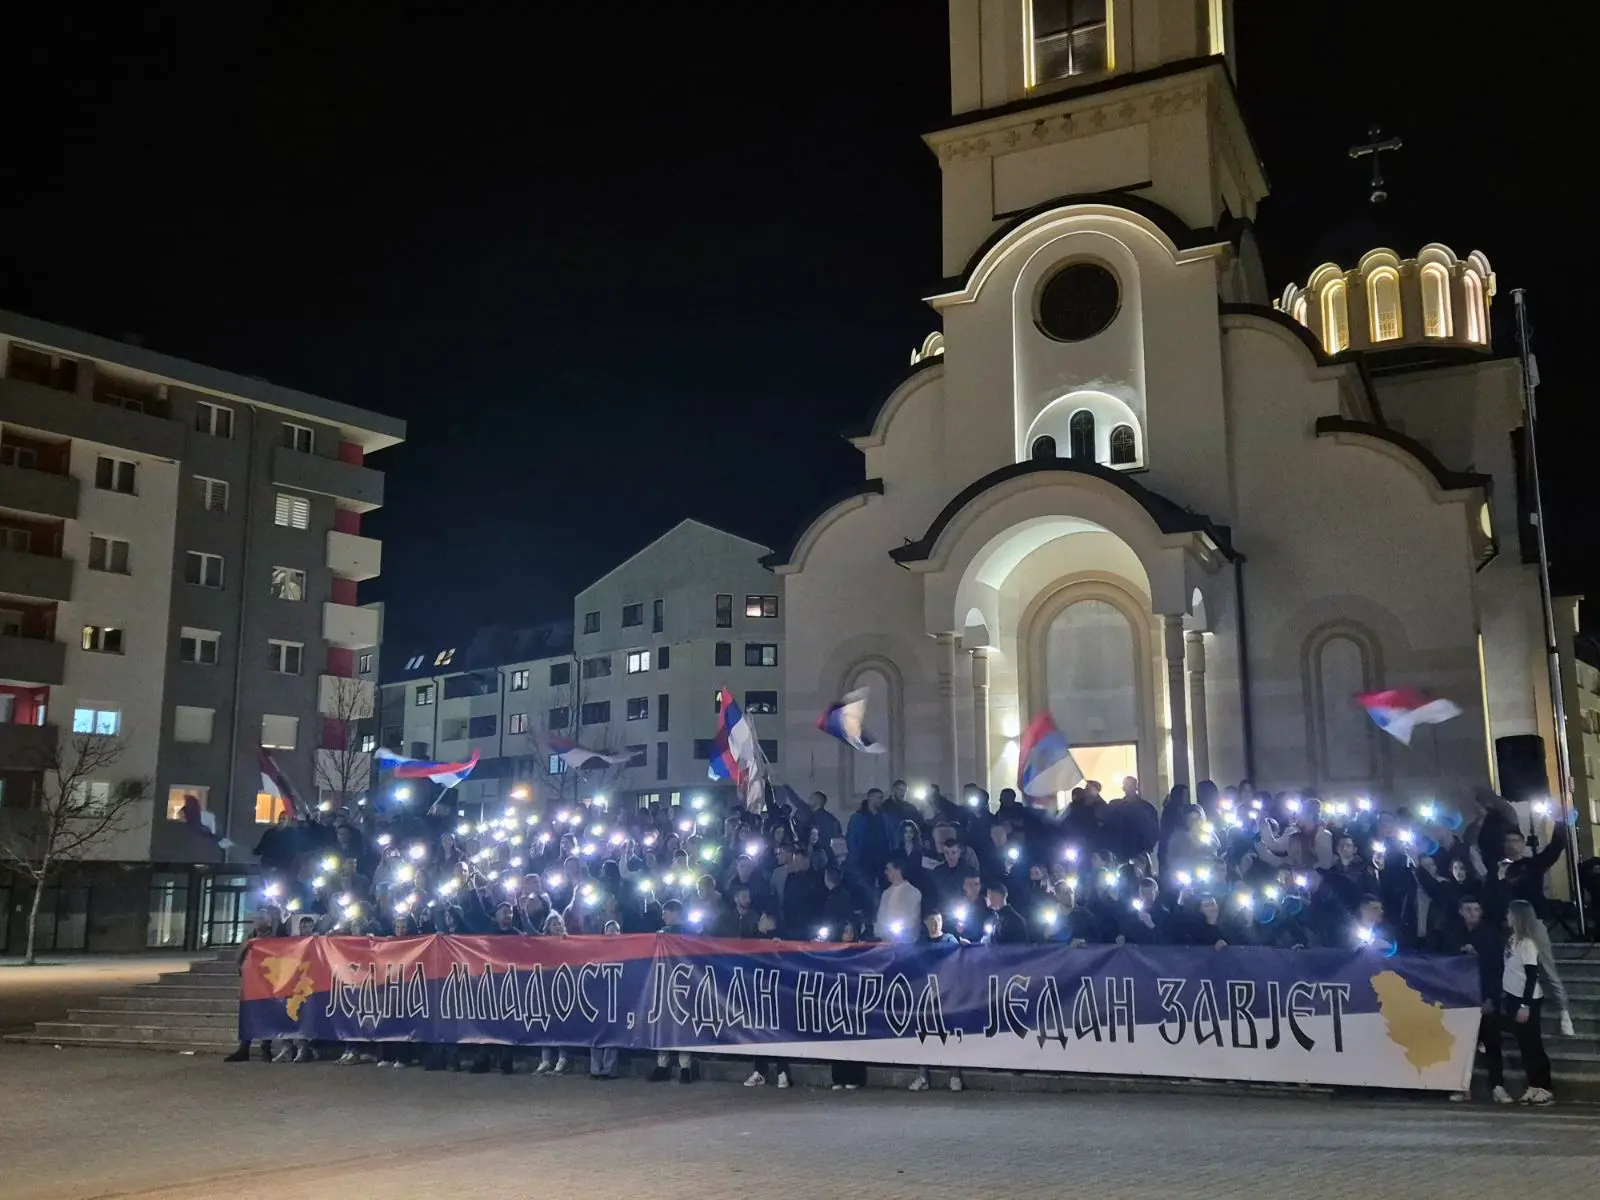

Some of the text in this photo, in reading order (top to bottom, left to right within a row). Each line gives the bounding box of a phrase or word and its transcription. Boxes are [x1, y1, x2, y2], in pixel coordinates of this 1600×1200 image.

[326, 962, 1351, 1052] ЈЕДНА МЛАДОСТ, ЈЕДАН НАРОД, ЈЕДАН ЗАВЈЕТ
